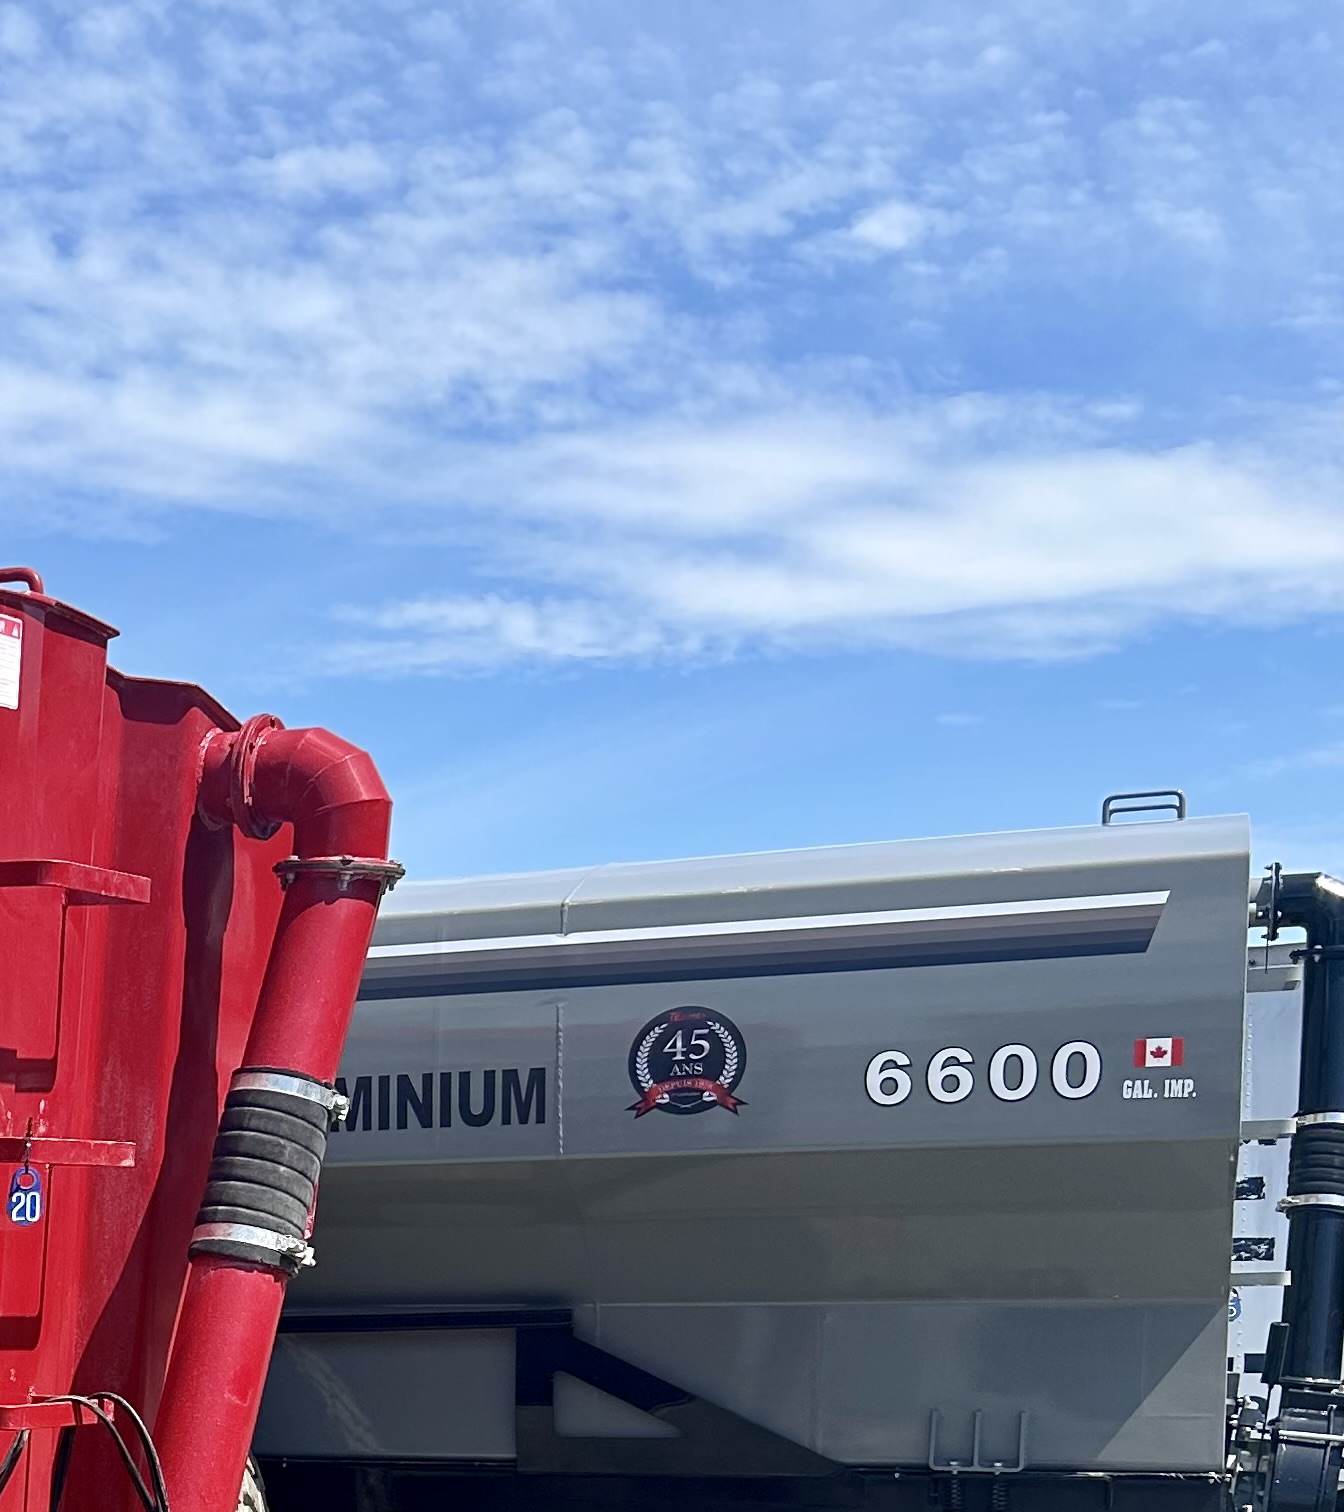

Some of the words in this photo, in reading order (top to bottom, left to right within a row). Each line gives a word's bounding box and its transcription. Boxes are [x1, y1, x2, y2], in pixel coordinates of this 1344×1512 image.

[662, 1028, 711, 1061] 45
[669, 1062, 704, 1077] ANS
[864, 1039, 1103, 1107] 6600
[1122, 1079, 1159, 1099] GAL.
[1163, 1078, 1197, 1099] IMP.
[11, 1191, 40, 1222] 20
